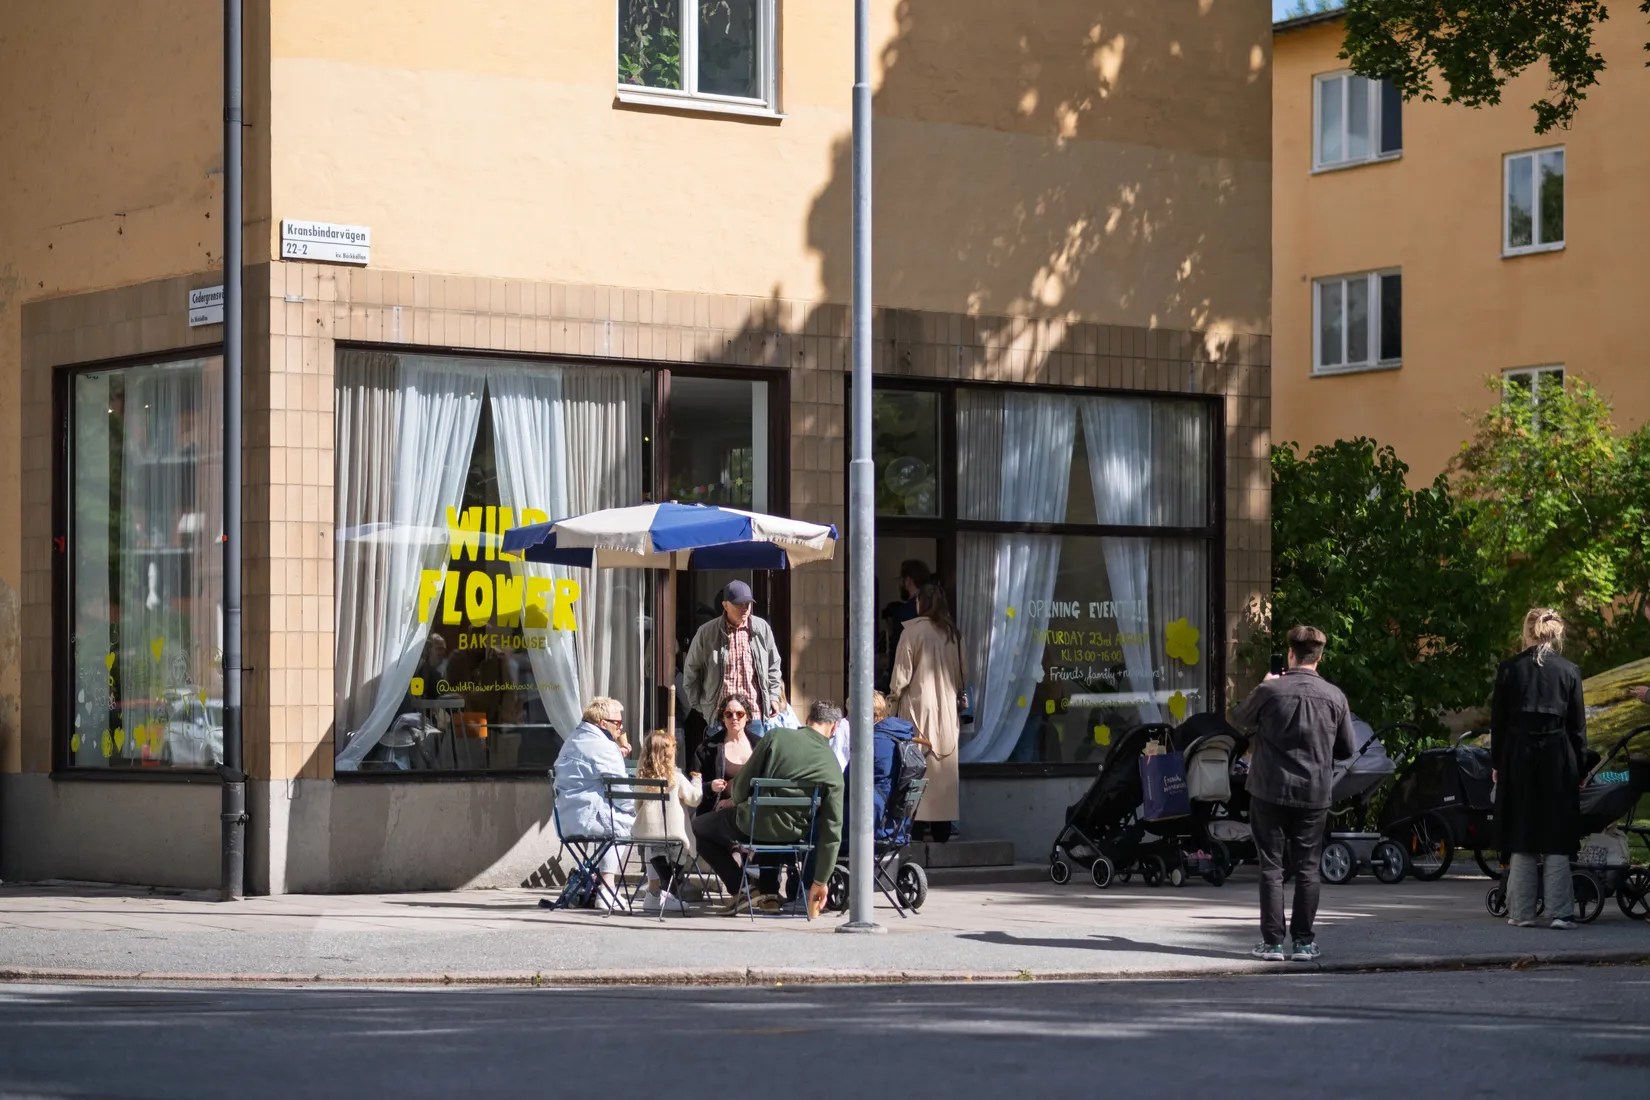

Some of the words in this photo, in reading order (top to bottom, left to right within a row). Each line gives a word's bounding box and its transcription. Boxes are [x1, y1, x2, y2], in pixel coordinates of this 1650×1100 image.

[287, 223, 366, 243] Kransbindarvägen
[286, 242, 308, 255] 22-2
[418, 569, 581, 632] FLOWER
[1028, 600, 1080, 619] OPENING
[458, 633, 546, 650] BAKEHOUSE
